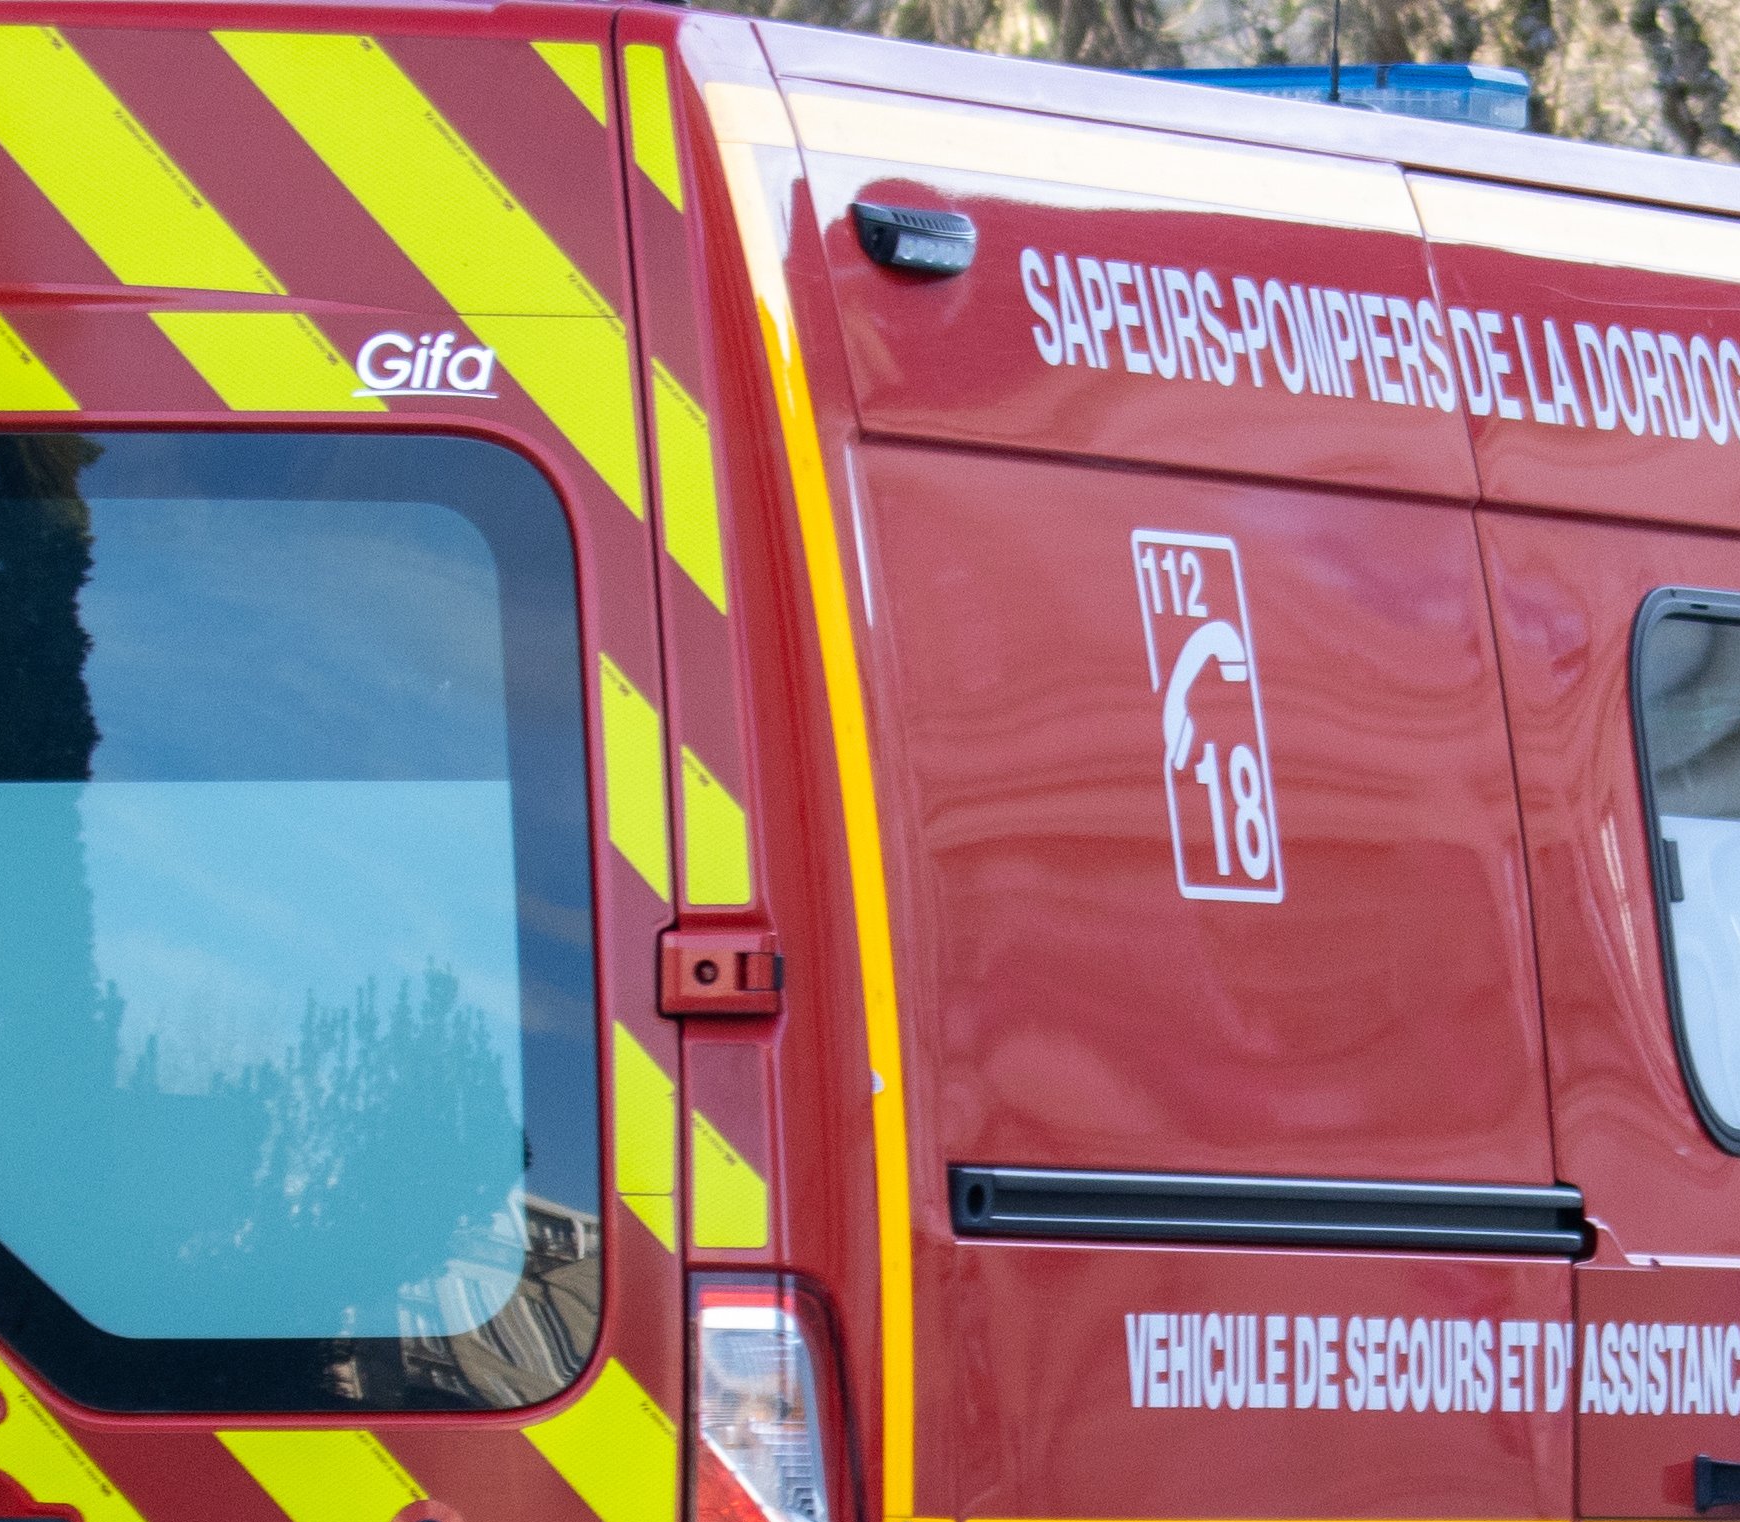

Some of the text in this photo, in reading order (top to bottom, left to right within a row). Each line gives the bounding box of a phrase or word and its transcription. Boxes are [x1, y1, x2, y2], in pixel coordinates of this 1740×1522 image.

[356, 330, 496, 391] Gifa
[1019, 246, 1457, 414] SAPEURS-POMPIERS
[1447, 307, 1524, 421] DE
[1512, 313, 1586, 428] LA
[1141, 547, 1209, 619] 112
[1194, 741, 1271, 881] 18
[1124, 1312, 1288, 1411] VEHICULE
[1293, 1315, 1340, 1411] DE
[1344, 1315, 1496, 1414] SECOURS
[1499, 1320, 1540, 1413] ET
